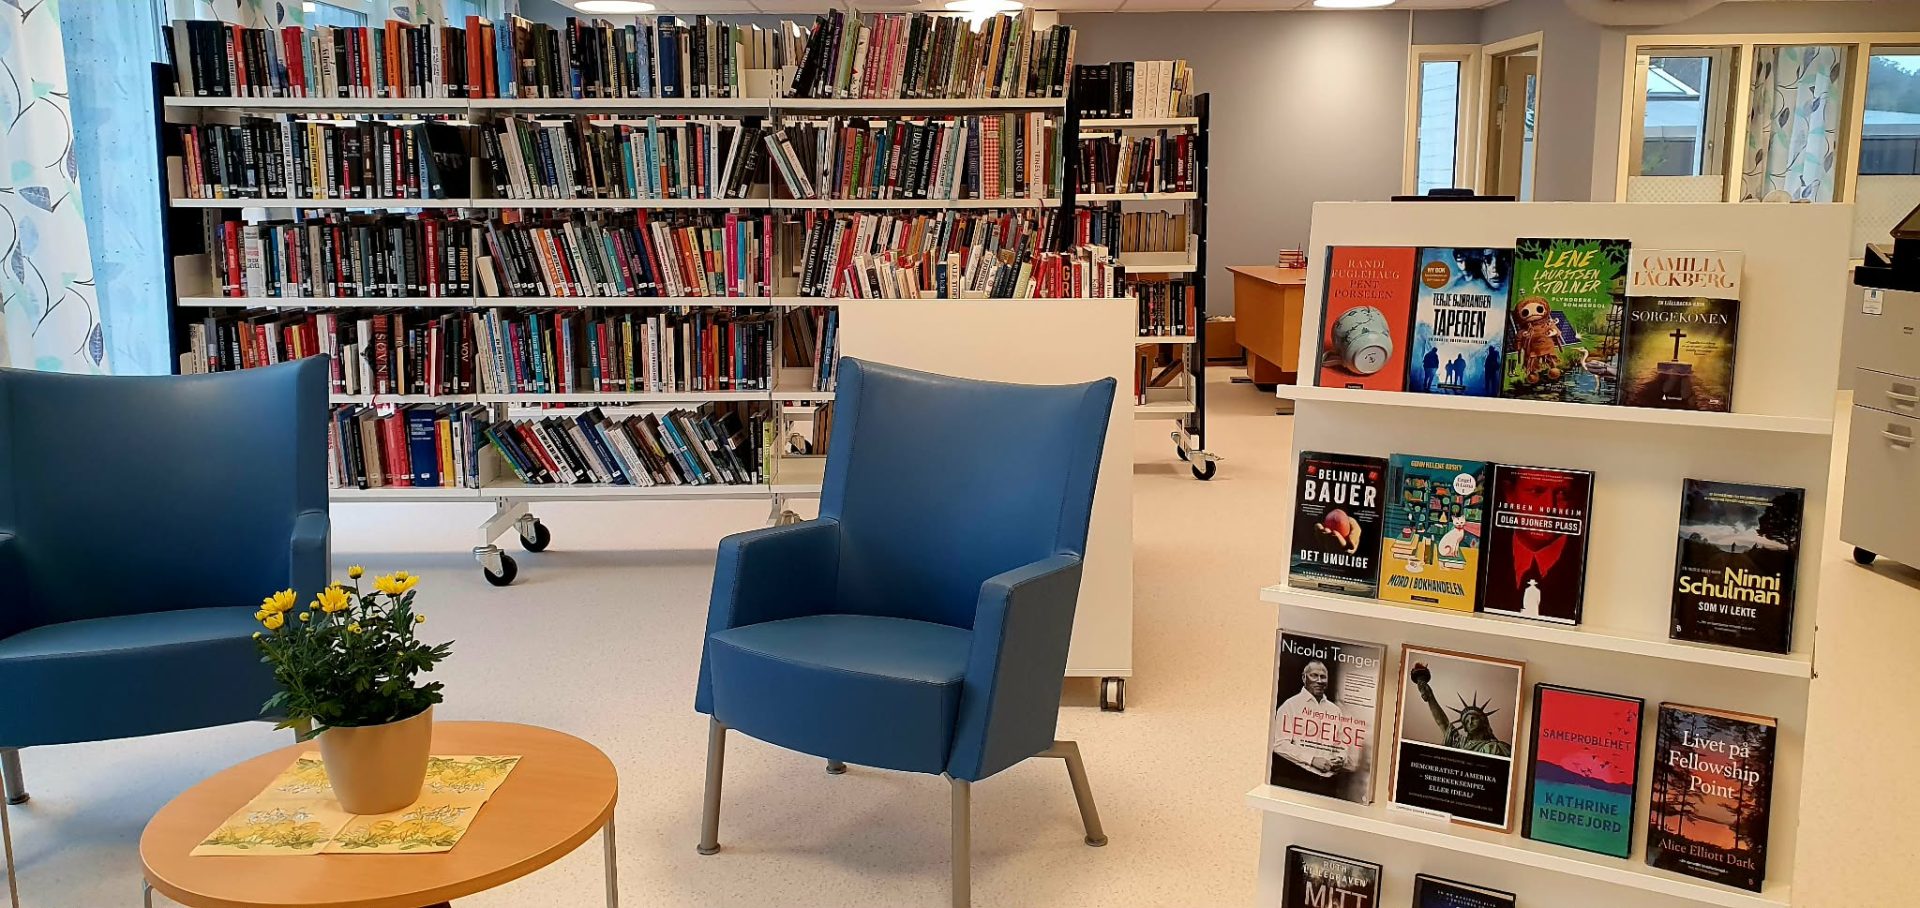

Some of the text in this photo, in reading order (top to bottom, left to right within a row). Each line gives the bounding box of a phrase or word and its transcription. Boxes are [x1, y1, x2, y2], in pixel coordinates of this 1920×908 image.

[911, 132, 923, 148] DEN
[910, 149, 921, 166] NYE
[459, 247, 469, 281] PROSESSEN
[1348, 259, 1385, 269] RANDI
[1544, 249, 1599, 269] LENE
[1643, 256, 1726, 272] CAMILLA
[1331, 269, 1400, 279] FUGLEHAUG
[1533, 269, 1600, 280] LAURITSEN
[1634, 270, 1734, 289] LÄCKBERG
[1334, 289, 1393, 299] PORSELEN
[1350, 280, 1380, 289] PENT
[1532, 280, 1602, 294] KJØLNER
[1433, 309, 1487, 338] TAPEREN
[1631, 310, 1728, 325] SORGEKONEN
[375, 333, 387, 374] SØVN
[1318, 469, 1365, 484] BELINDA
[1304, 480, 1377, 508] BAUER
[1500, 515, 1519, 525] OLGA
[1555, 521, 1578, 532] PLASS
[1300, 549, 1369, 569] DET UMULIGE
[1387, 574, 1409, 587] MORD
[1413, 578, 1465, 596] BOKHANDELEN
[1724, 566, 1781, 591] Ninni
[1678, 575, 1781, 606] Schulman
[1698, 601, 1757, 618] SOM VI LEKTE
[1281, 639, 1380, 668] Nicolai Tanger
[1302, 707, 1312, 716] Alt
[1312, 710, 1324, 719] jeg
[1326, 711, 1338, 720] har
[1354, 718, 1366, 726] om
[1283, 715, 1366, 748] LEDELSE
[1543, 728, 1632, 752] SAMEPROBLEMET
[1682, 730, 1750, 760] Livet på
[1410, 761, 1460, 776] DEMOKRATIET
[1464, 771, 1497, 783] AMERIKA
[1668, 750, 1760, 787] Fellowship
[1428, 784, 1450, 795] ELLER
[1690, 775, 1735, 799] Point
[1544, 791, 1618, 816] KATHRINE
[1539, 807, 1622, 833] NEDREJORD
[1658, 838, 1687, 853] Alice
[1689, 844, 1724, 862] Elliott
[1727, 854, 1756, 871] Dark
[1323, 860, 1348, 873] RUTH
[1304, 881, 1368, 908] MITT
